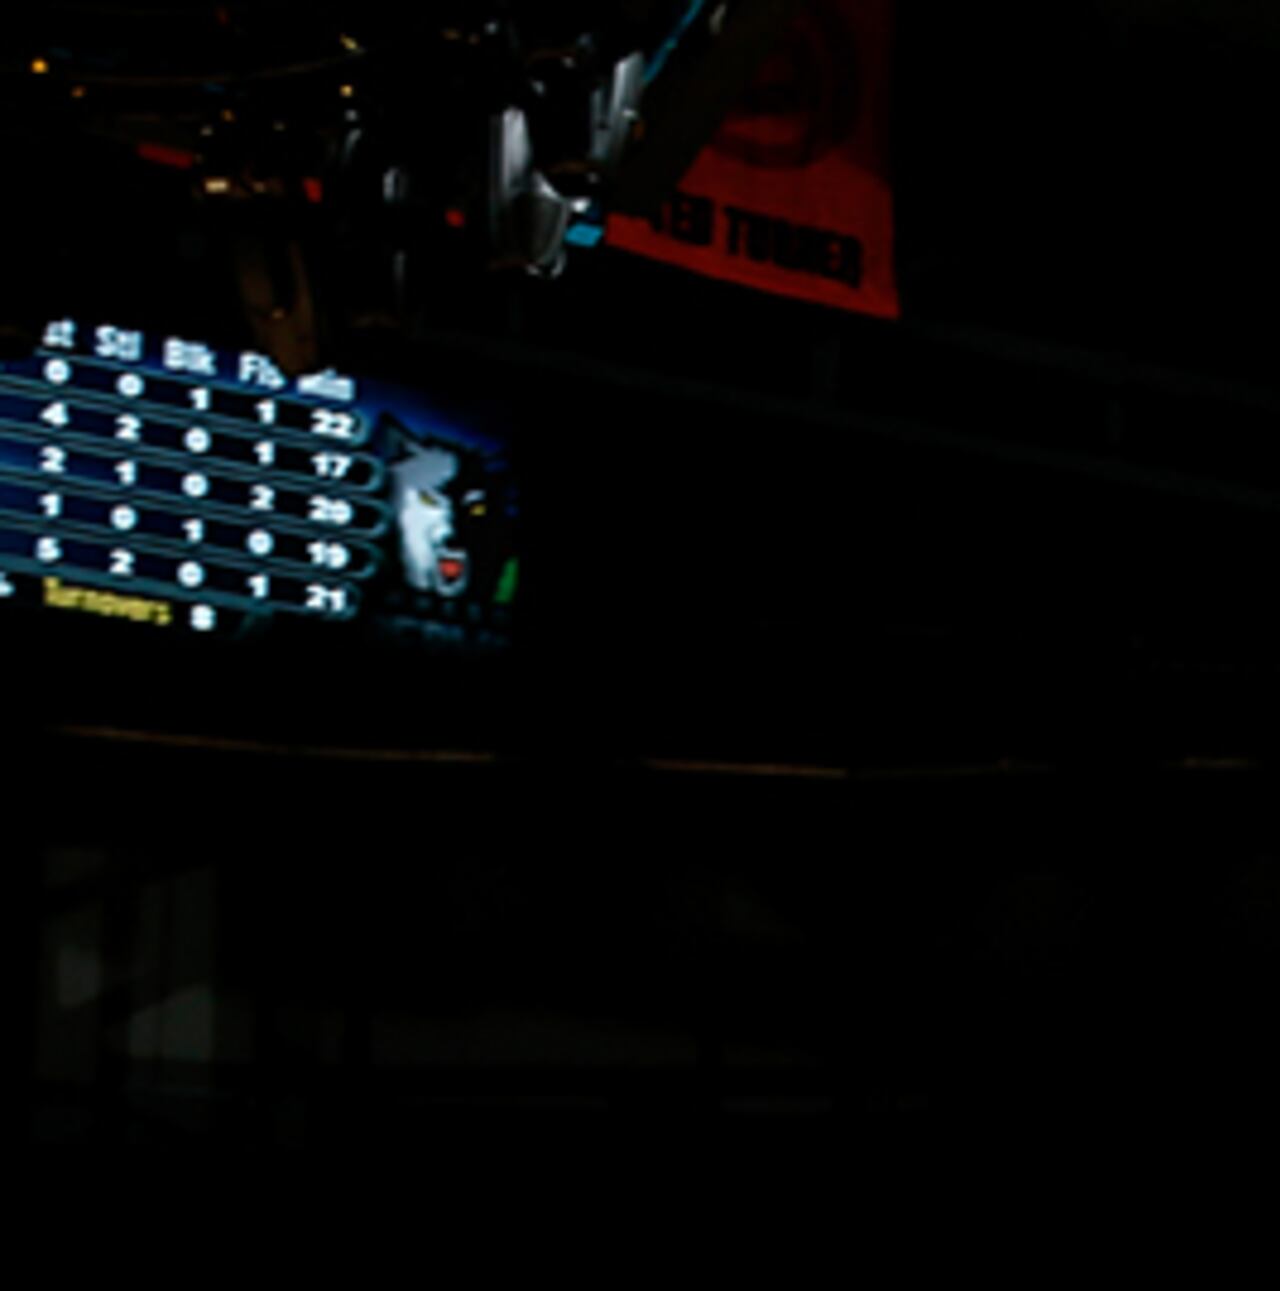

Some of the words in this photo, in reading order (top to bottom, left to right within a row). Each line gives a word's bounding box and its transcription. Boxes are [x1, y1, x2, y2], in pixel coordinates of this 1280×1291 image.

[43, 357, 72, 385] 0
[116, 372, 145, 398] 0
[189, 386, 210, 412] 1
[256, 399, 277, 426] 1
[310, 407, 354, 441] 22
[39, 400, 70, 427] 4
[115, 412, 142, 442] 2
[253, 439, 276, 466] 1
[311, 451, 354, 479] 17
[39, 444, 67, 475] 2
[114, 459, 137, 487] 1
[250, 483, 276, 512] 2
[39, 492, 62, 518] 1
[182, 518, 204, 544] 1
[108, 548, 136, 576] 2
[247, 573, 270, 599] 1
[305, 583, 348, 613] 21
